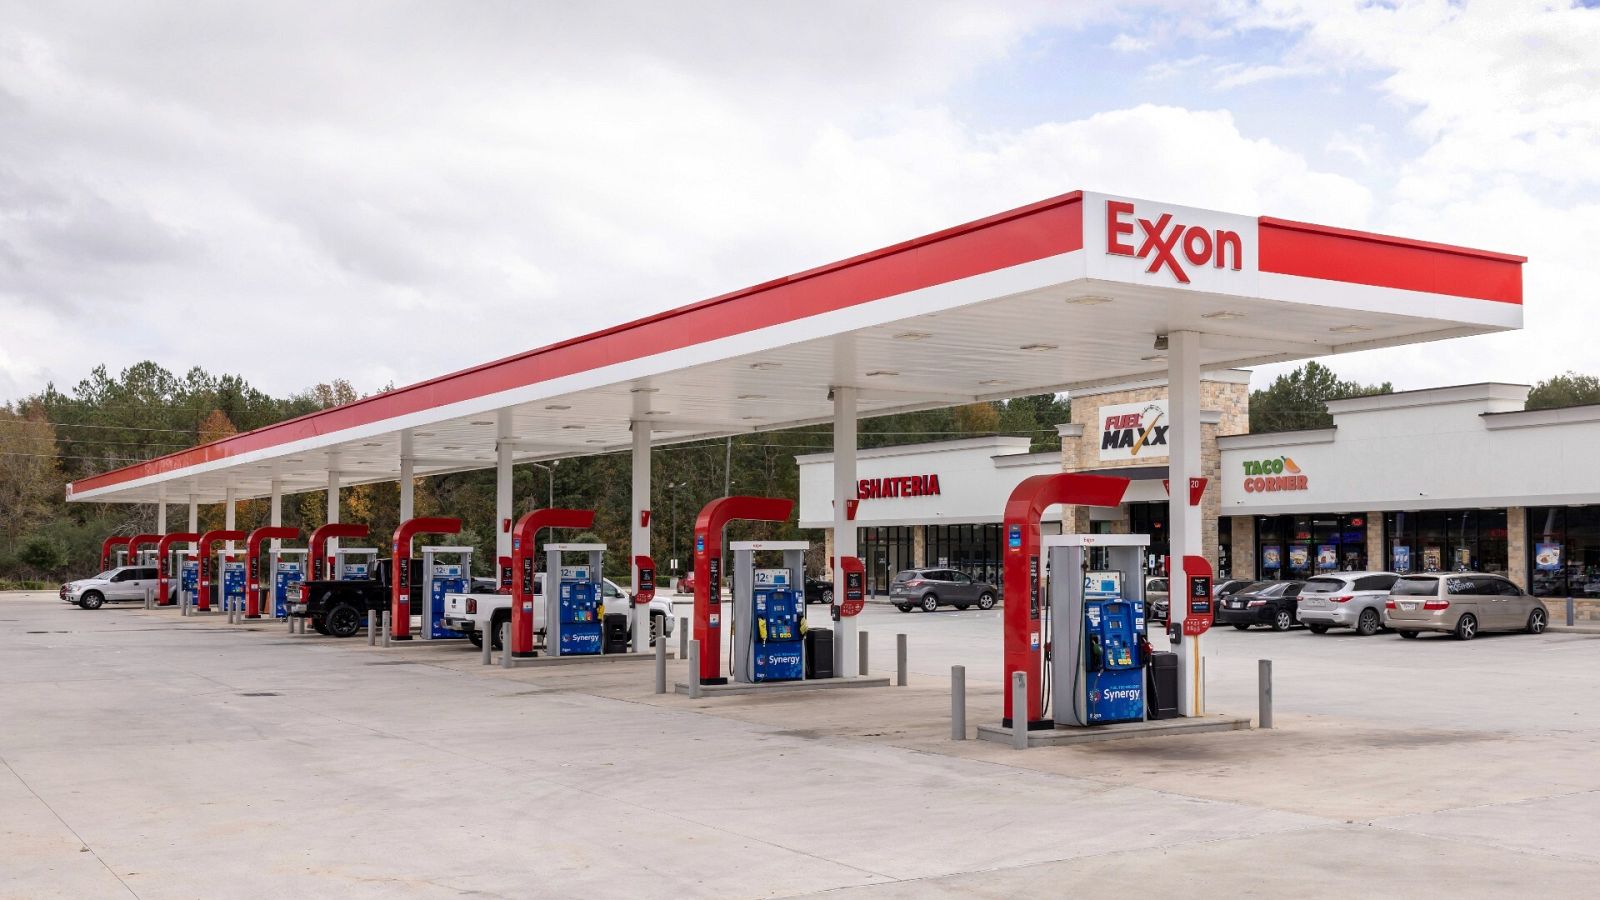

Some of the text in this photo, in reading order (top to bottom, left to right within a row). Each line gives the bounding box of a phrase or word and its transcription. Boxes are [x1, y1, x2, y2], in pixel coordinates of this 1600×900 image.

[1106, 200, 1243, 284] Exxon
[1105, 413, 1142, 430] FUEL
[1101, 426, 1169, 449] MAXX
[1243, 459, 1283, 475] TACO
[856, 474, 941, 499] SHATERIA
[1191, 480, 1199, 488] 20
[1244, 475, 1308, 493] CORNER
[572, 634, 599, 642] Synergy
[769, 655, 800, 665] Synergy
[1103, 688, 1140, 702] Synergy
